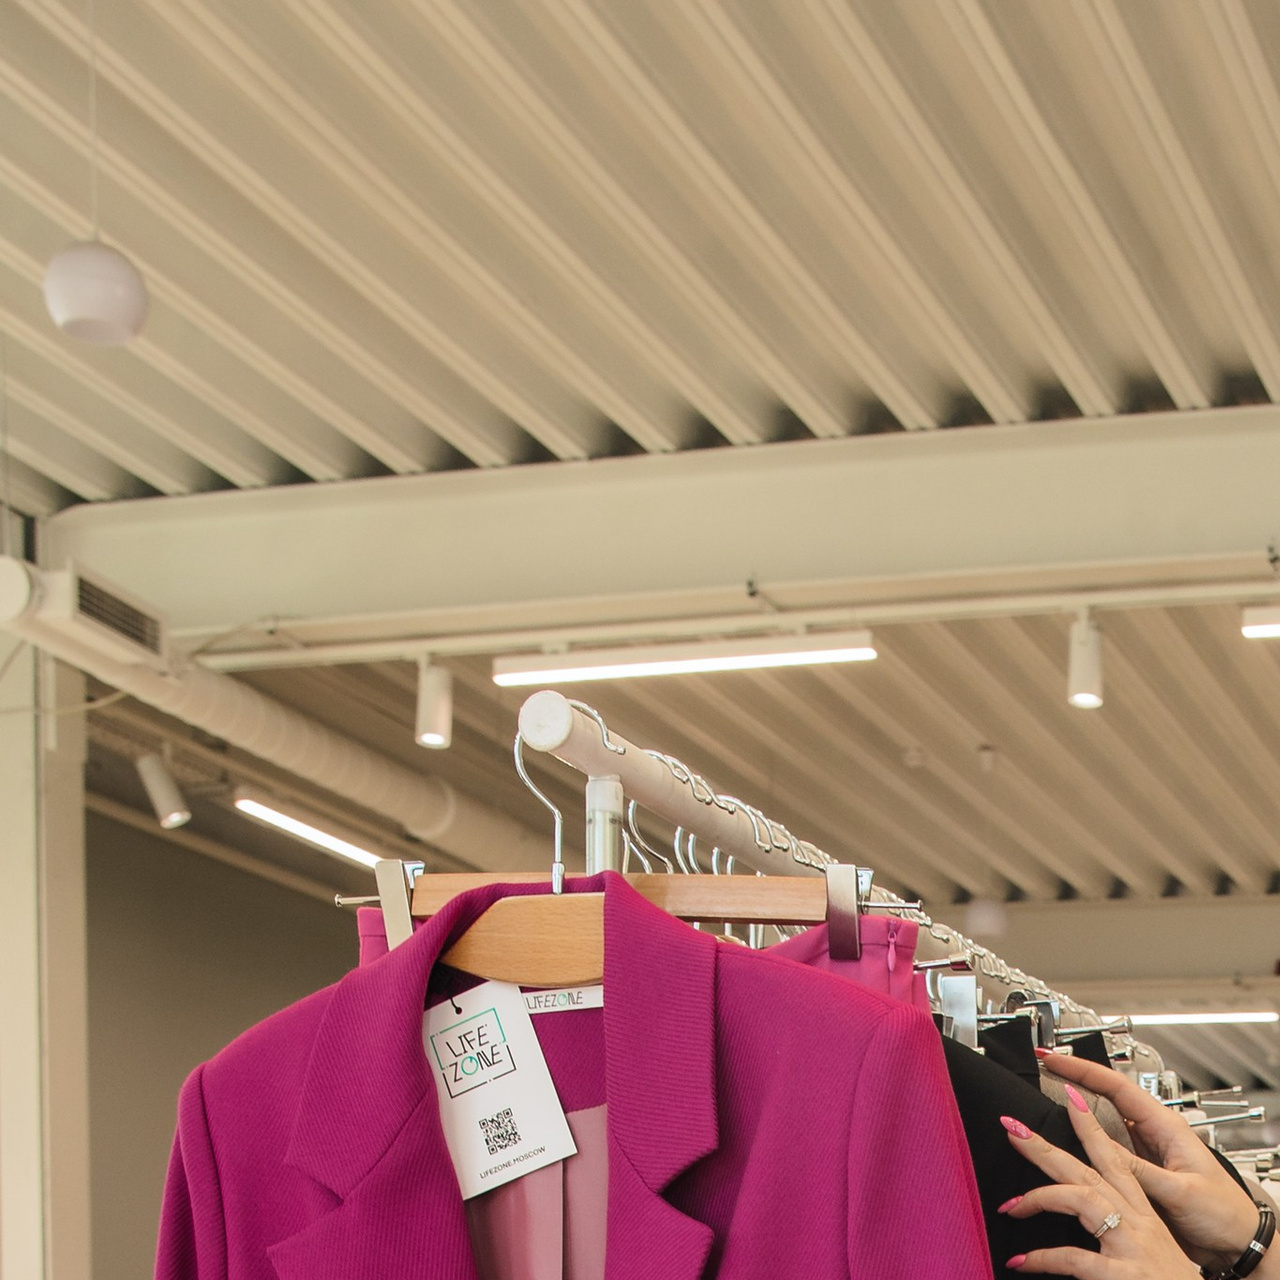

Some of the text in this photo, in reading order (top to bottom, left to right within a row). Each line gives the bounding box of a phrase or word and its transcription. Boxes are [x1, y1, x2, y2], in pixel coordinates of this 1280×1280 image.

[526, 991, 584, 1010] LIFEZONE
[446, 1025, 490, 1058] LIFE
[448, 1043, 503, 1083] ZONE
